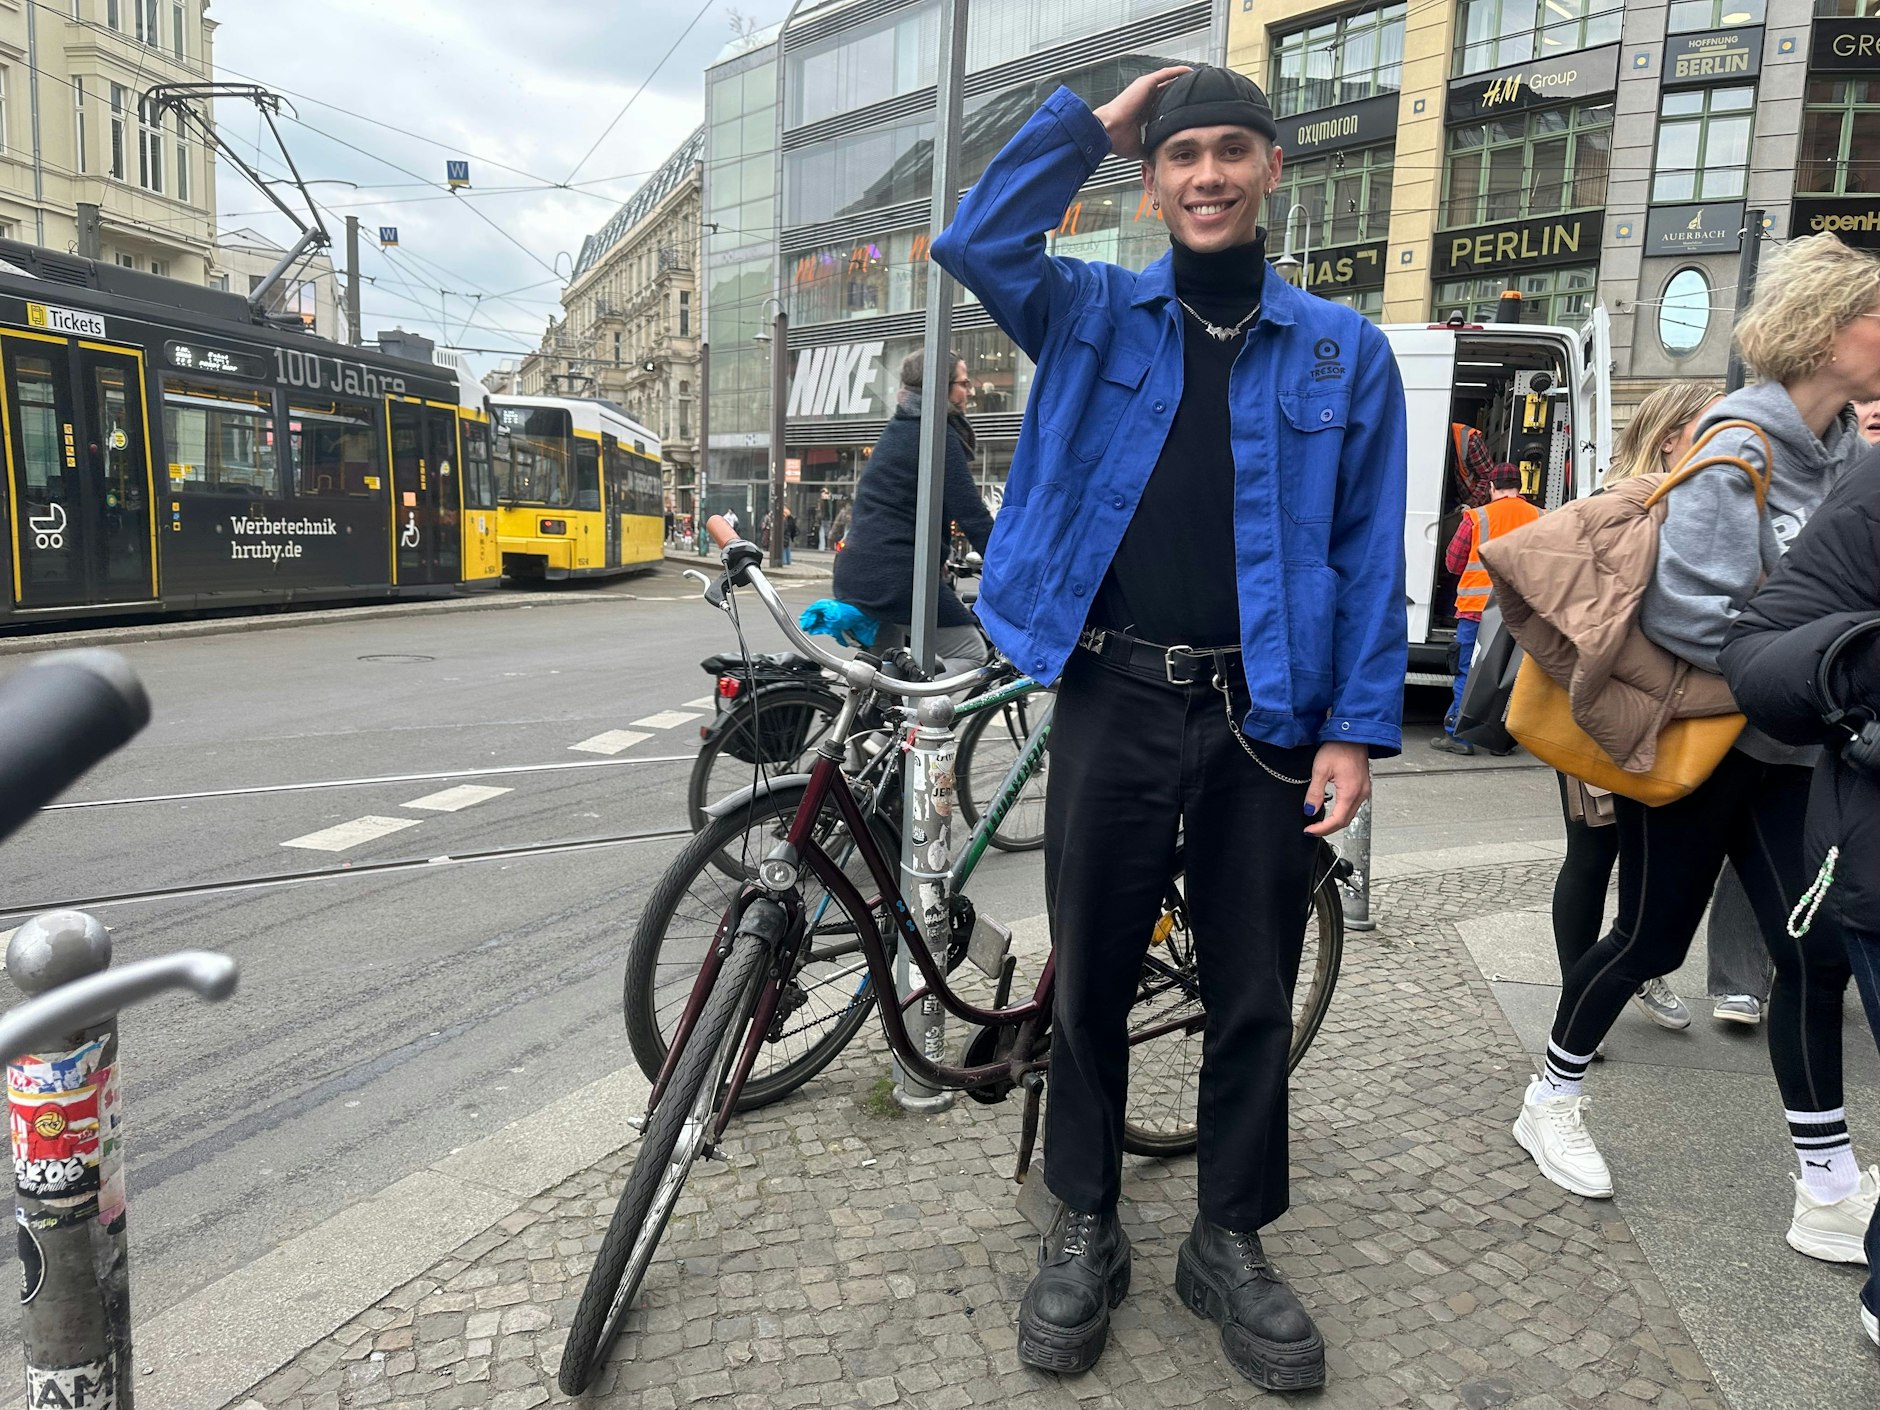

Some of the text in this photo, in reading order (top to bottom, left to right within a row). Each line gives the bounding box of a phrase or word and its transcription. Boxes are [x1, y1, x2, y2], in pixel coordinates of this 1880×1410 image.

[1688, 35, 1739, 49] HOFFNUNG
[1832, 34, 1880, 57] GR
[1675, 54, 1749, 78] BERLIN
[1482, 70, 1577, 107] H&M Group
[1297, 114, 1358, 146] oxymoron
[450, 162, 466, 178] W
[381, 228, 396, 241] W
[1451, 222, 1580, 267] PERLIN
[1661, 230, 1726, 242] AUERBACH
[50, 310, 102, 335] Tickets
[274, 346, 321, 389] 100
[786, 341, 884, 416] NIKE
[1310, 366, 1346, 378] TRESOR
[230, 516, 337, 535] Werbetechnik
[231, 540, 302, 563] hruby.de
